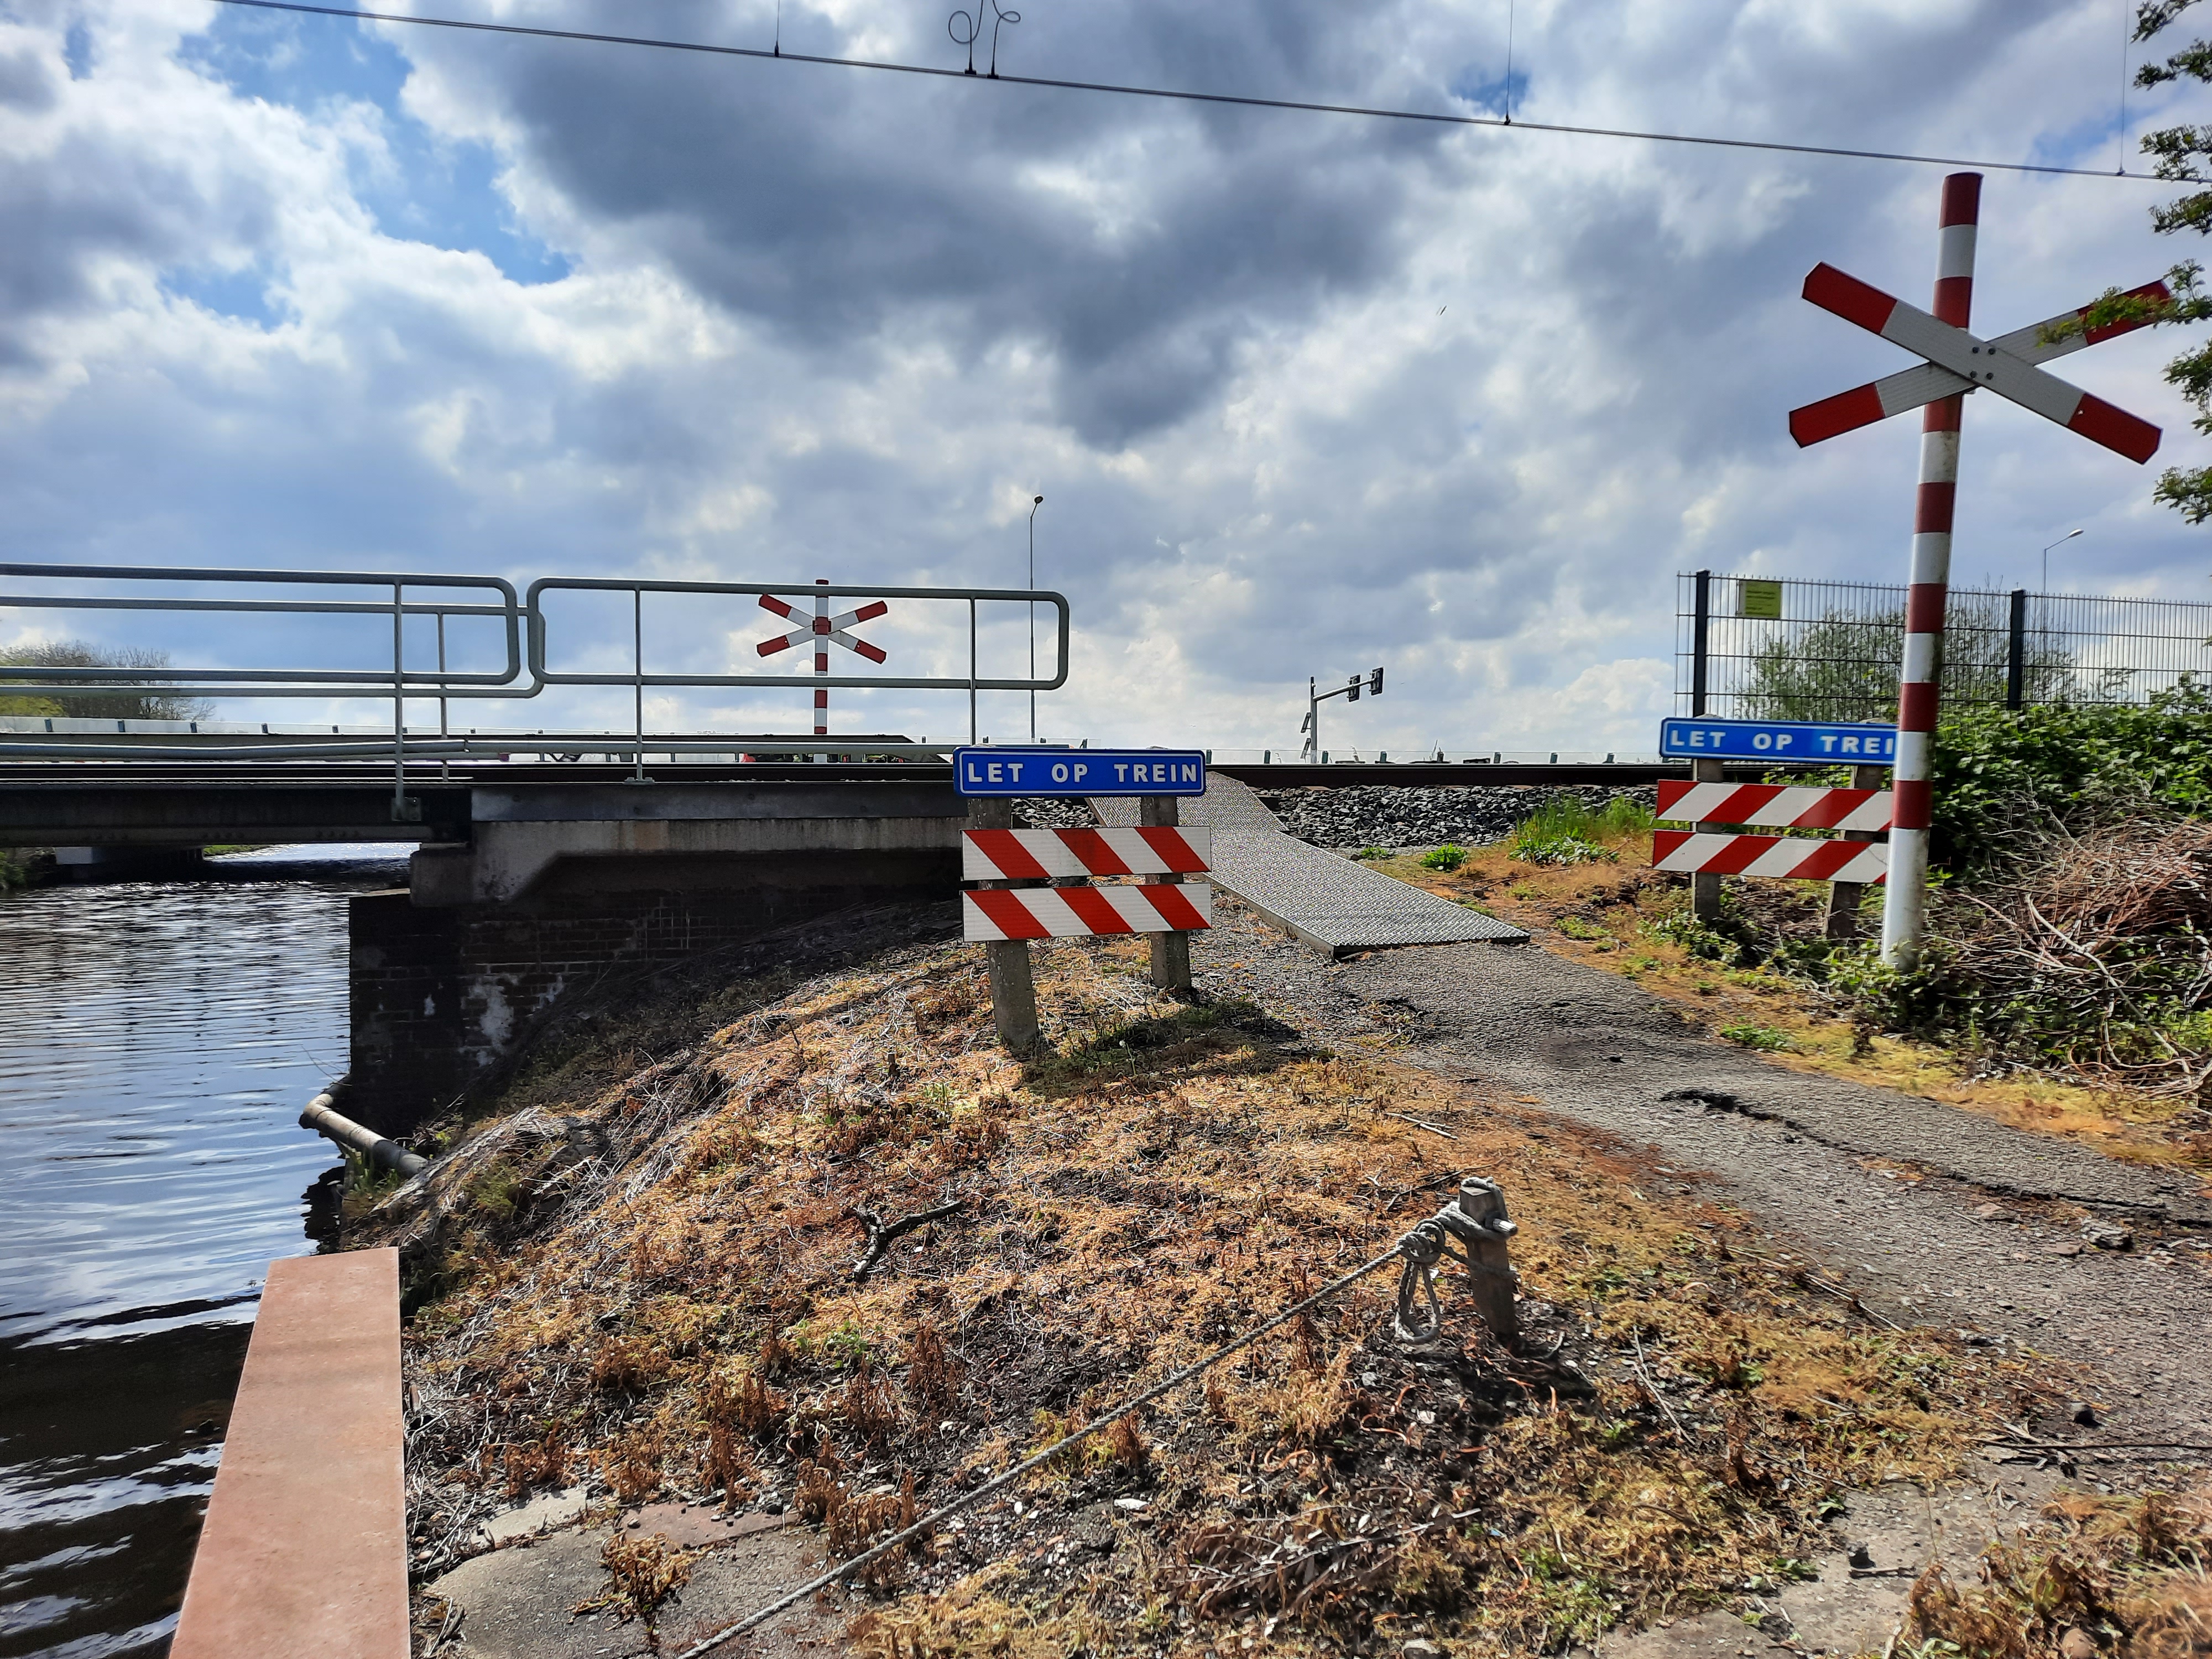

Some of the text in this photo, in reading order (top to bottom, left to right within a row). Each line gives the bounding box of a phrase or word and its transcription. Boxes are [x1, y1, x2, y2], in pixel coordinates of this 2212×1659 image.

[1670, 729, 1894, 755] LET OP TREI
[967, 762, 1197, 783] LET OP TREIN
